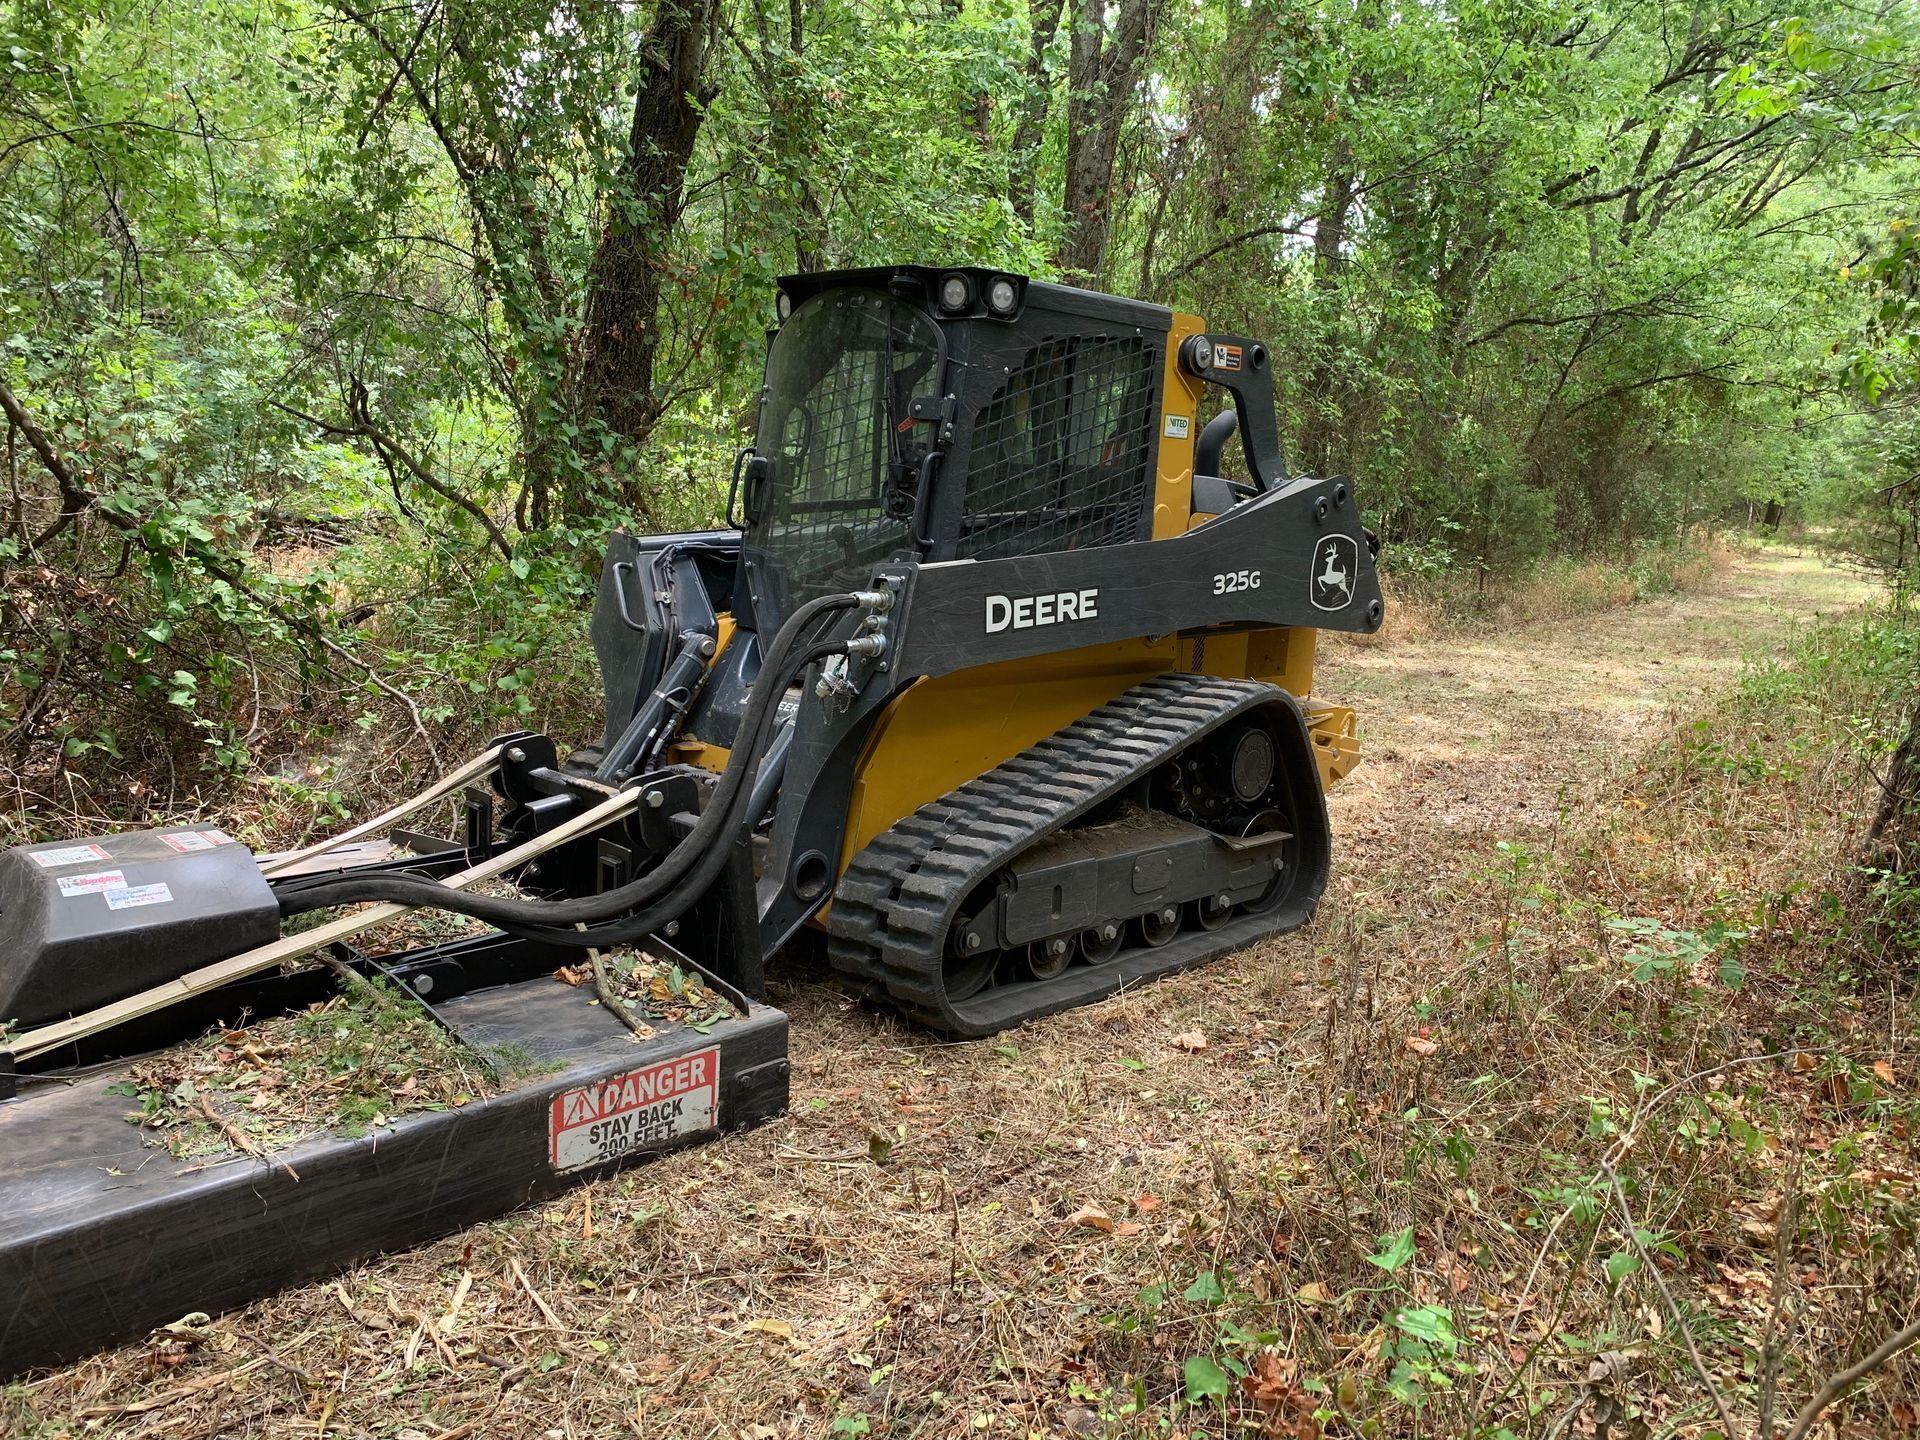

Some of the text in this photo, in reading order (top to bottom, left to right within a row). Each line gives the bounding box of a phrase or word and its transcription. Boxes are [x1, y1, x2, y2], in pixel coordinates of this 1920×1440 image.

[1213, 570, 1261, 595] 325G
[985, 588, 1099, 634] DEERE
[778, 702, 800, 712] EER
[604, 1058, 706, 1114] DANGER
[589, 1097, 684, 1145] STAY BACK
[598, 1119, 677, 1161] 200 FEET
